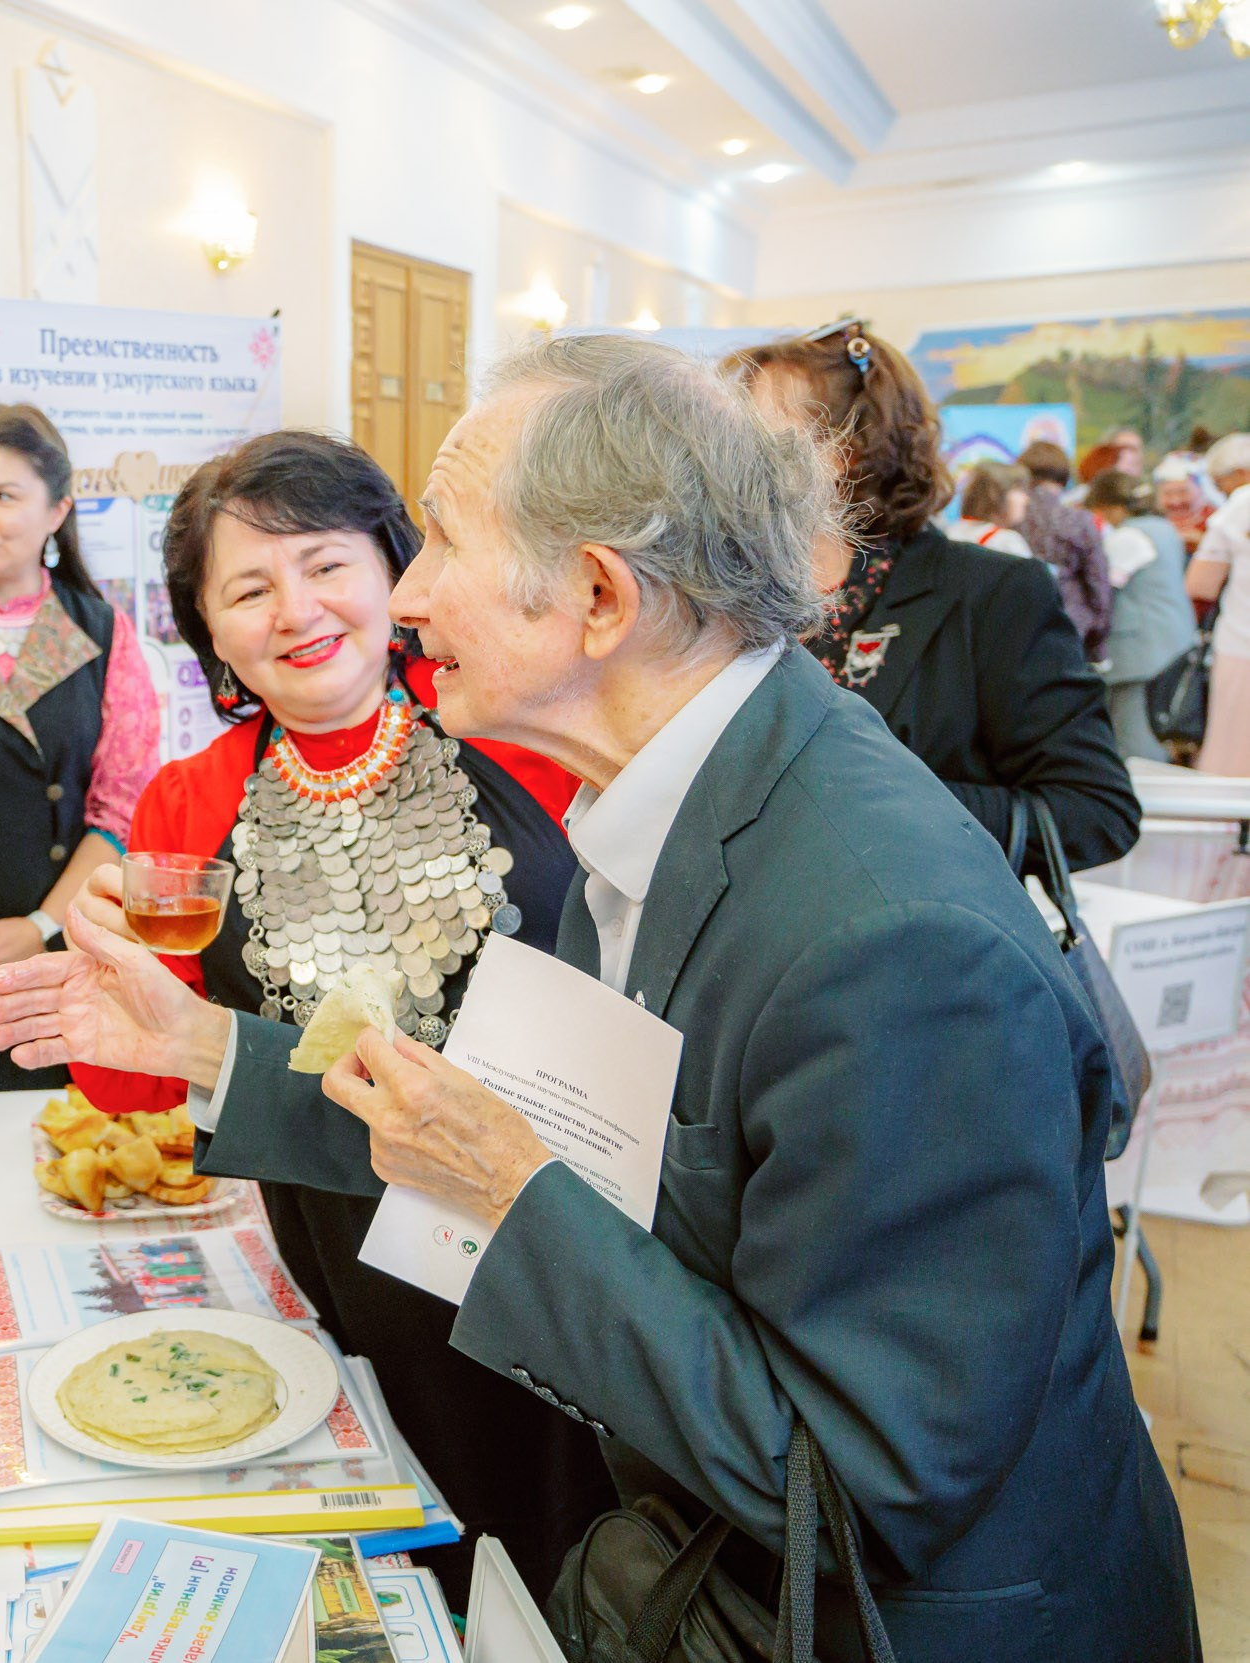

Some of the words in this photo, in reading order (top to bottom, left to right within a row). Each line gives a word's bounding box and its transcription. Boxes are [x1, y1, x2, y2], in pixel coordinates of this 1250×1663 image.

[39, 328, 220, 363] Преемственность
[9, 367, 98, 391] изучении
[102, 371, 204, 395] удмуртского
[208, 375, 258, 393] языка
[466, 1053, 481, 1065] VIII
[481, 1059, 537, 1089] Международной
[536, 1084, 604, 1121] научно-практической
[603, 1117, 641, 1146] конференции
[536, 1069, 589, 1100] ПРОГРАММА
[477, 1076, 516, 1097] «Родные
[516, 1092, 548, 1112] языки:
[548, 1106, 588, 1132] единство,
[588, 1126, 624, 1151] развитие
[563, 1126, 614, 1159] поколений»,
[588, 1168, 622, 1192] института
[119, 1575, 166, 1645] "Удмуртия"
[204, 1567, 239, 1622] юнматон
